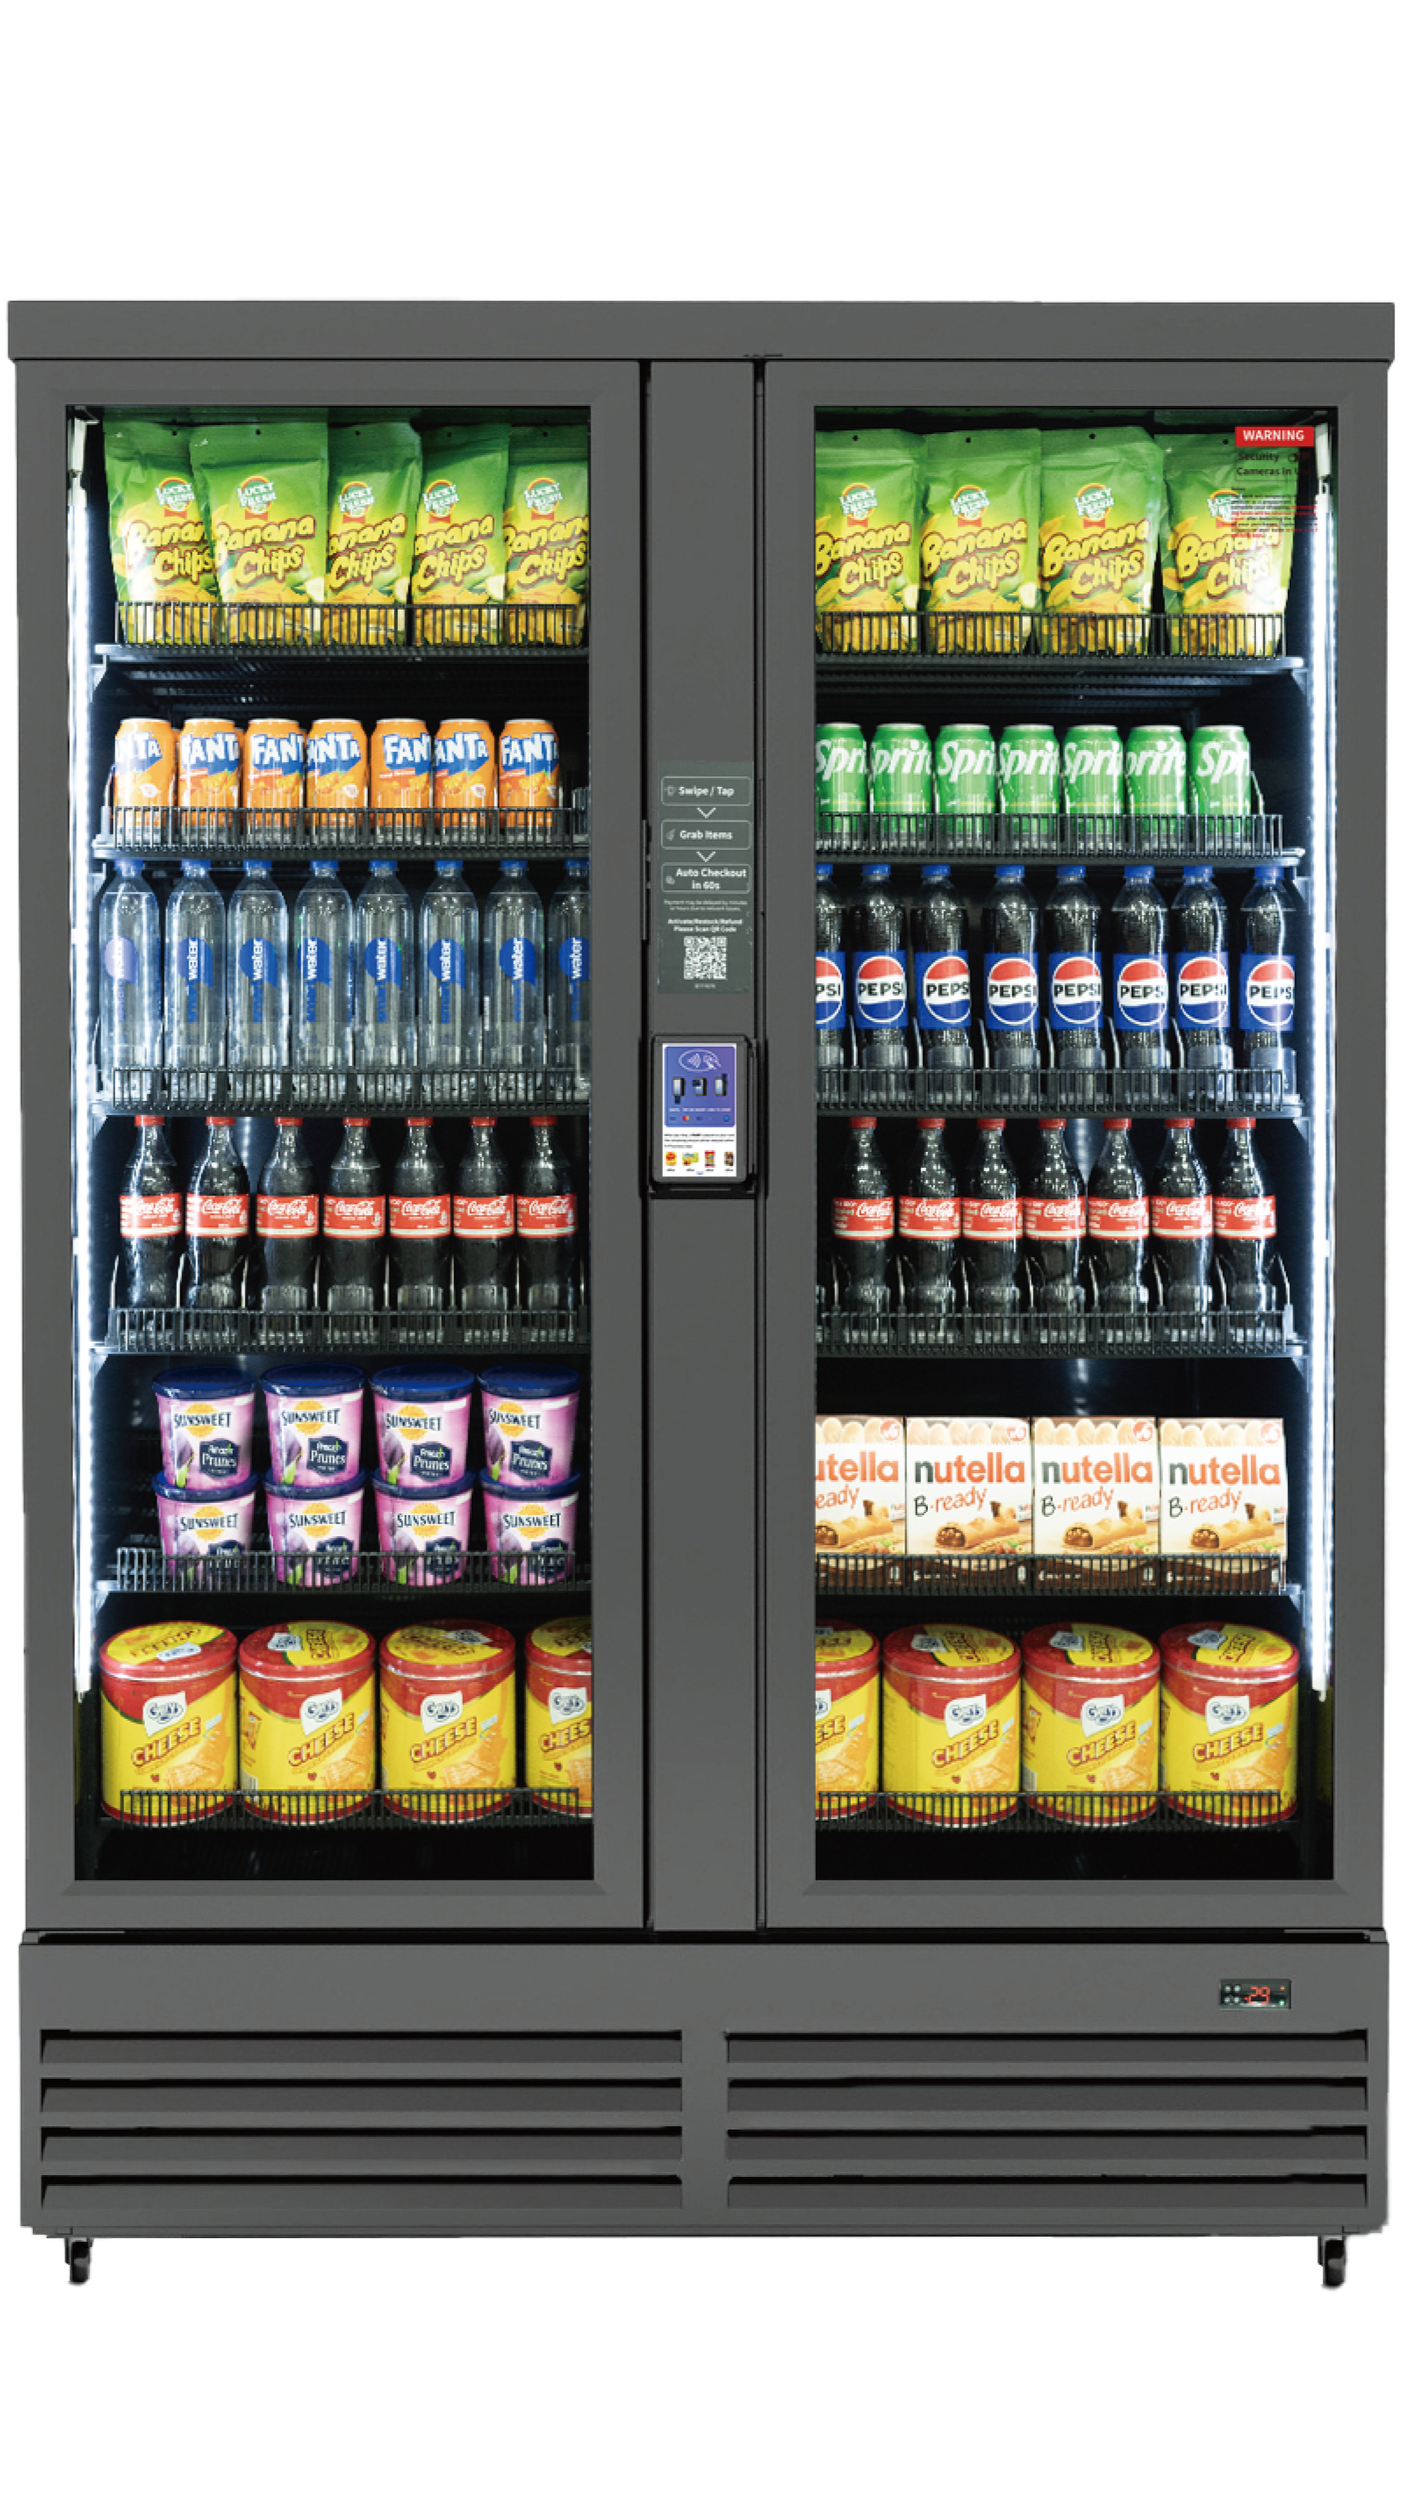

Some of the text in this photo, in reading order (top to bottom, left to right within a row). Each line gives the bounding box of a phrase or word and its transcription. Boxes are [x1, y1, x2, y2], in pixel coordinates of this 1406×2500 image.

[1243, 429, 1304, 441] WARNING
[1236, 467, 1280, 476] Cameras
[1238, 452, 1279, 463] Security
[216, 514, 317, 568] Banana
[816, 521, 913, 578] Banana
[921, 518, 1028, 580] Banana
[1042, 518, 1151, 580] Banana
[235, 545, 305, 587] Chips
[330, 542, 396, 590] Chips
[417, 544, 487, 590] Chips
[517, 541, 587, 588] Chips
[838, 550, 904, 597] Chips
[947, 549, 1021, 597] Chips
[1071, 549, 1145, 598] Chips
[1205, 553, 1271, 598] Chips
[677, 786, 709, 798] Swipe
[717, 786, 735, 798] Tap
[679, 830, 733, 840] Grab Items
[676, 867, 747, 877] Auto Checkout
[1053, 983, 1101, 998] PEPSI
[173, 1411, 232, 1429] SUNSWEET
[281, 1408, 341, 1427] SUNSWEET
[386, 1413, 443, 1432] SUNSWEET
[489, 1407, 542, 1431] SUNSWEET
[311, 1450, 346, 1465] Prunes
[413, 1455, 449, 1471] Prunes
[914, 1451, 1026, 1484] nutella
[1041, 1452, 1155, 1484] nutella
[1168, 1454, 1281, 1486] nutella
[913, 1485, 988, 1518] B-ready
[1041, 1485, 1114, 1518] B-ready
[1168, 1488, 1243, 1519] B-ready
[179, 1513, 240, 1532] SUNSWEET
[289, 1511, 348, 1529] SUNSWEET
[396, 1511, 456, 1529] SUNSWEET
[502, 1512, 562, 1531] SUNSWEET
[132, 1717, 201, 1767] CHEESE
[288, 1712, 355, 1767] CHEESE
[410, 1717, 477, 1763] CHEESE
[931, 1719, 999, 1769] CHEESE
[1067, 1720, 1137, 1767] CHEESE
[1193, 1722, 1264, 1765] CHEESE
